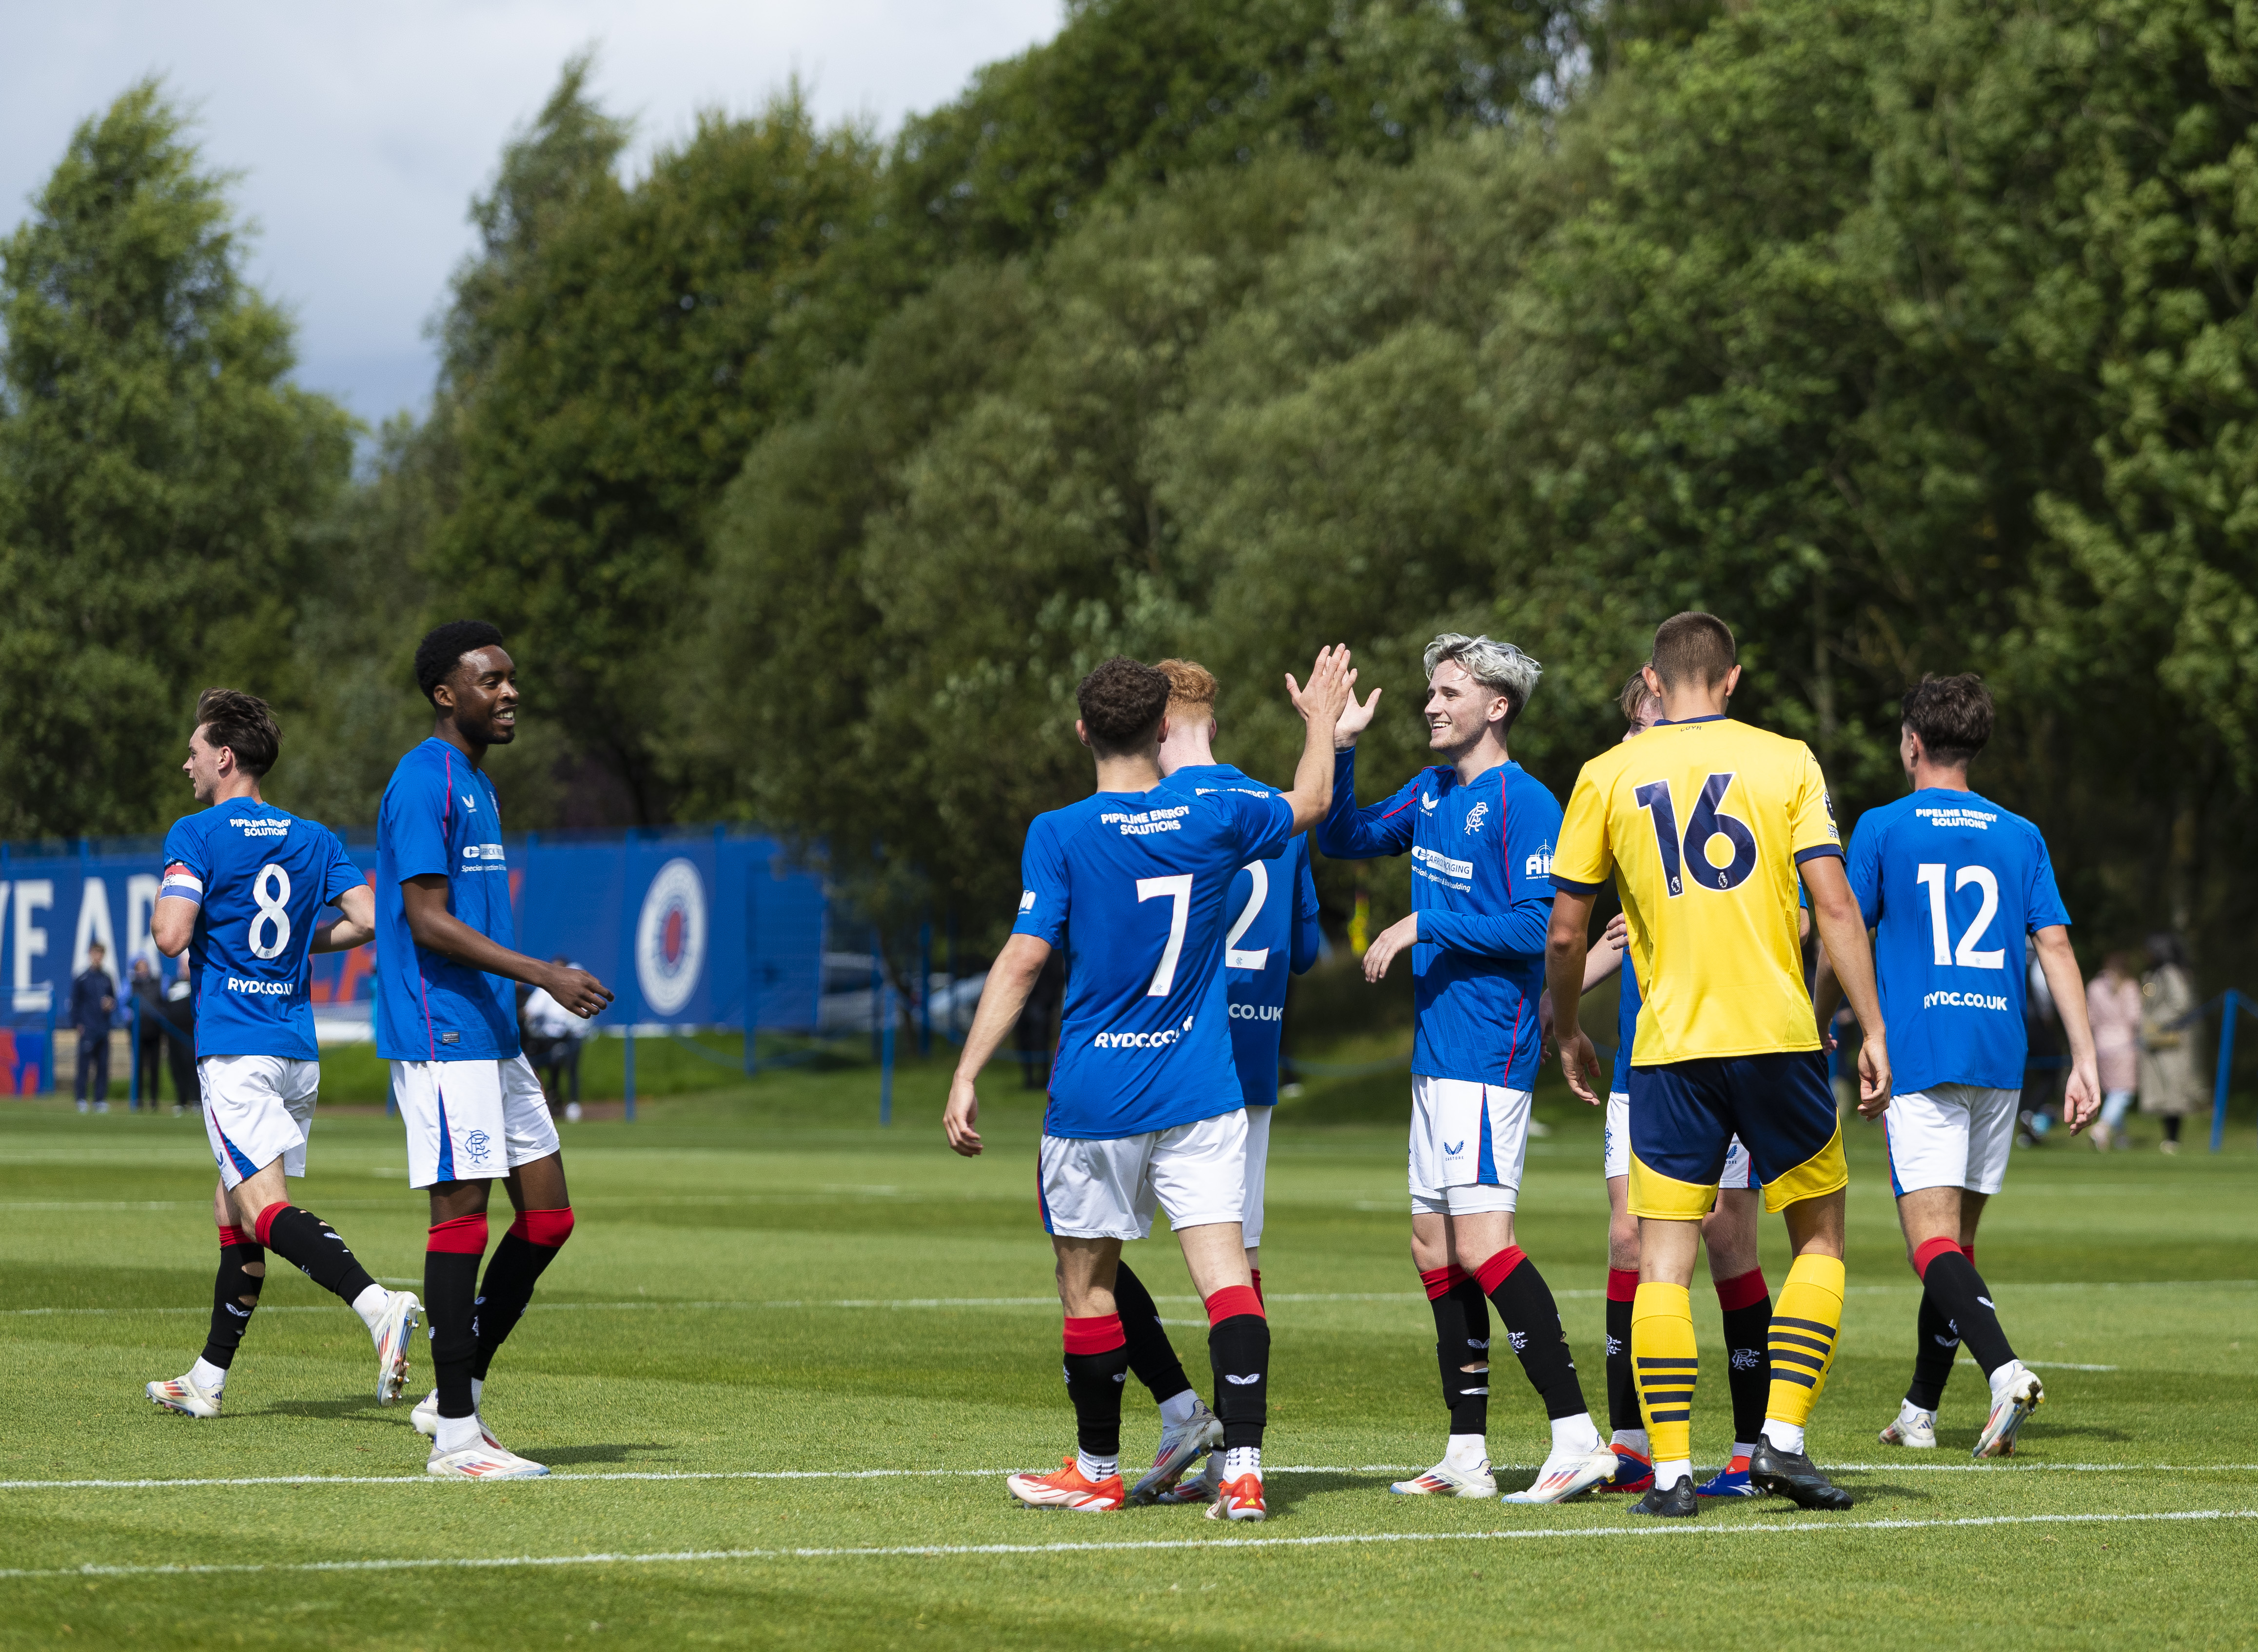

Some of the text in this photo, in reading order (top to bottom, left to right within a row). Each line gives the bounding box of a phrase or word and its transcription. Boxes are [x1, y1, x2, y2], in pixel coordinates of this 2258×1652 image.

[229, 819, 268, 827] PIPELINE
[1100, 806, 1190, 824] PIPELINE ENERGY
[1915, 808, 1997, 823] PIPELINE ENERGY
[1931, 817, 1988, 830] SOLUTIONS
[244, 827, 288, 837] SOLUTIONS
[1120, 820, 1181, 835] SOLUTIONS
[1633, 772, 1758, 898] 16
[1526, 855, 1554, 875] AI
[248, 863, 291, 959] 8
[1225, 859, 1270, 970] 2
[1917, 863, 2005, 969] 12
[1136, 873, 1194, 997] 7
[228, 977, 294, 996] RYDC.CO.U
[1924, 991, 2007, 1011] RYDC.CO.UK
[1228, 1003, 1284, 1022] CO.UK
[1094, 1015, 1194, 1048] RYDC.CO.K
[1434, 1472, 1463, 1486] F50
